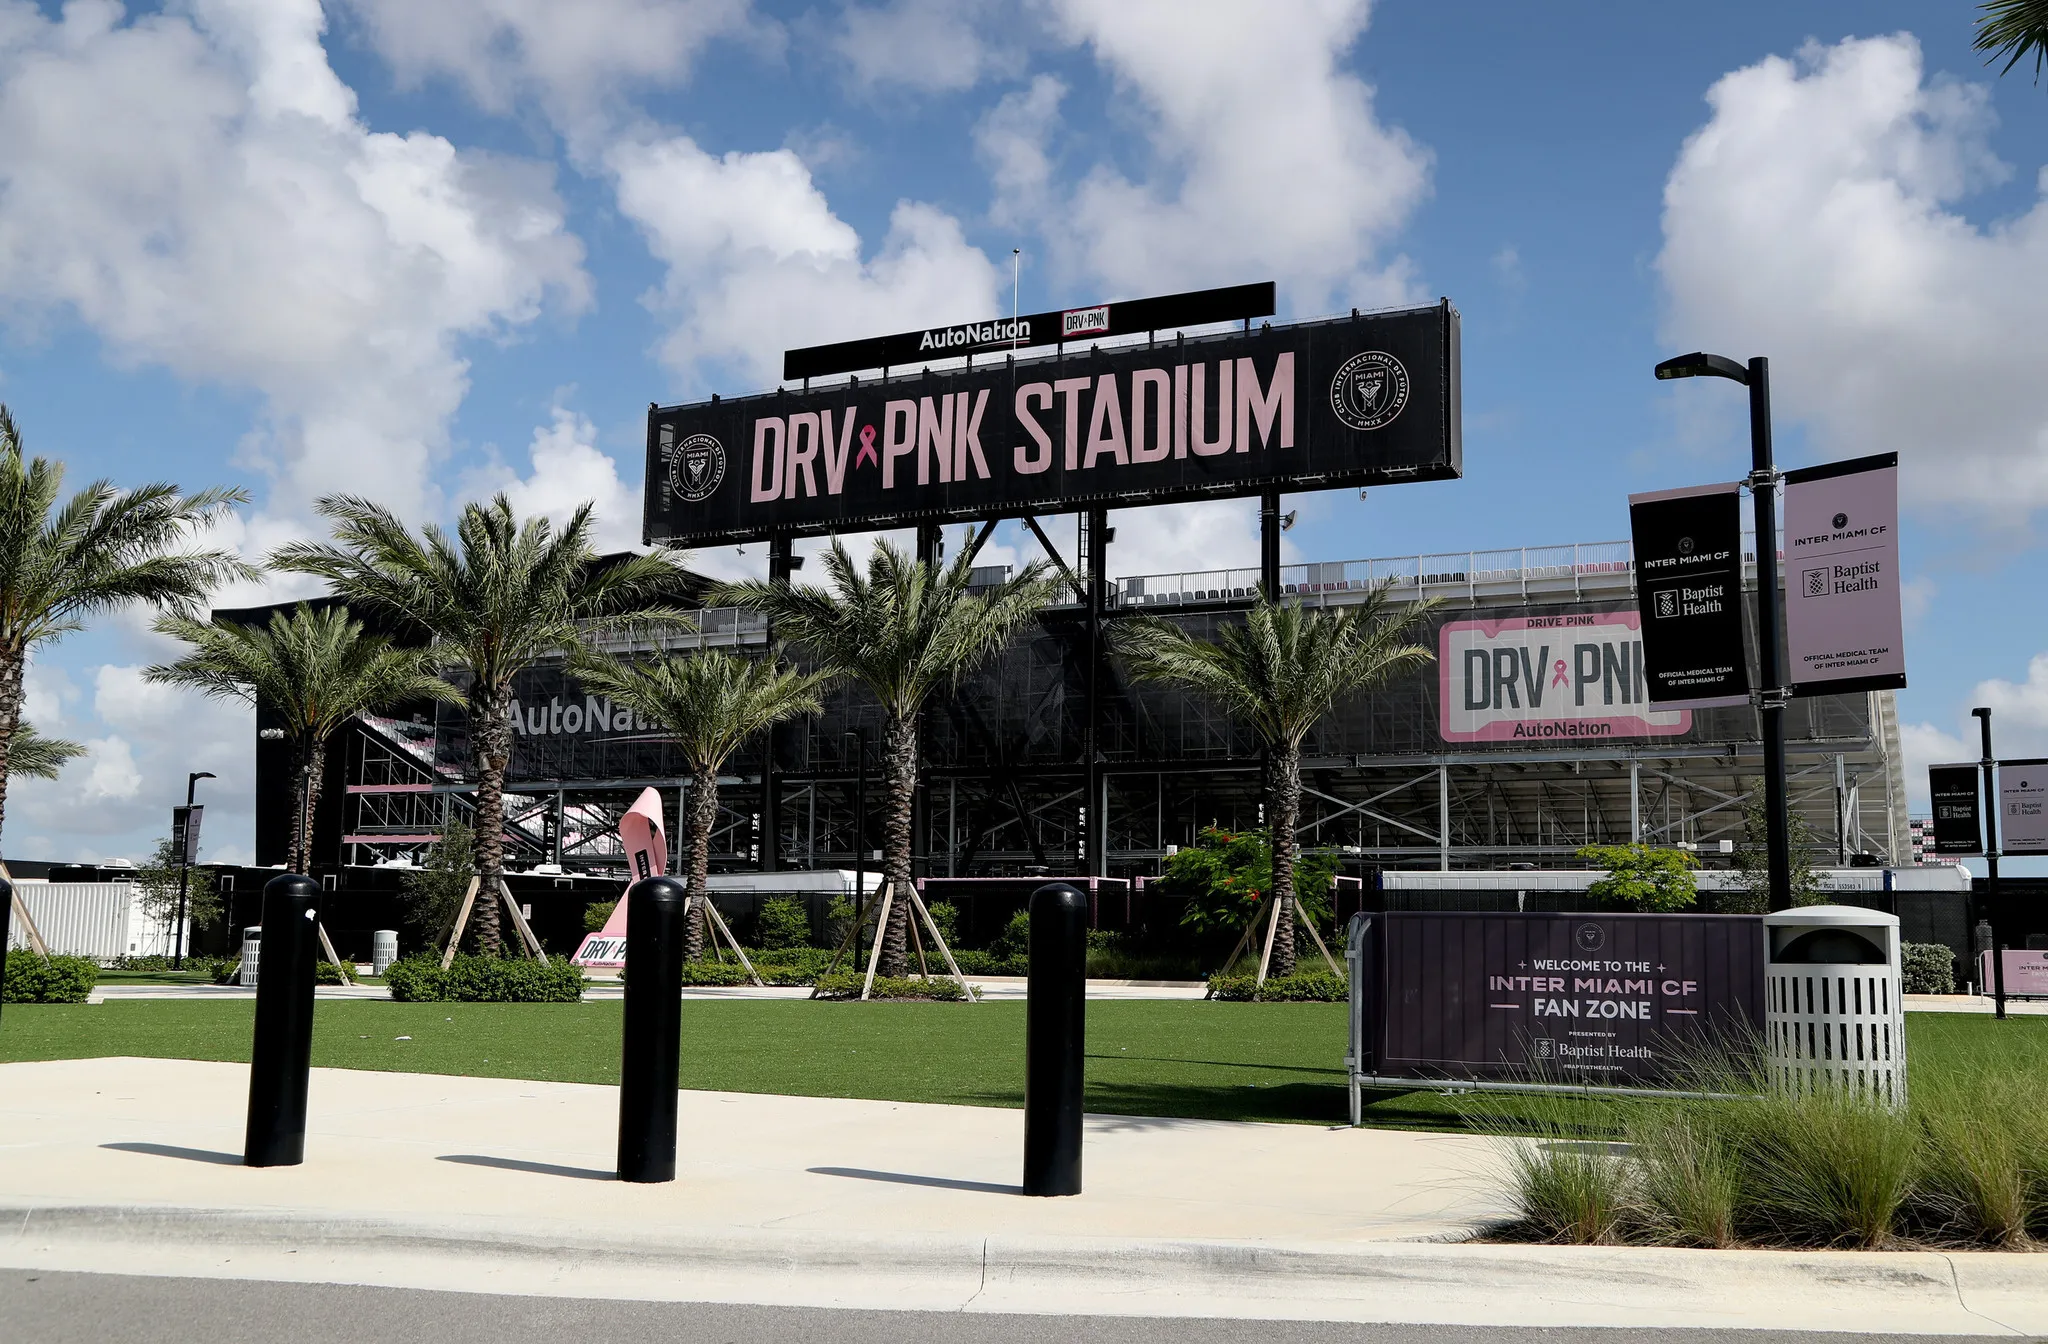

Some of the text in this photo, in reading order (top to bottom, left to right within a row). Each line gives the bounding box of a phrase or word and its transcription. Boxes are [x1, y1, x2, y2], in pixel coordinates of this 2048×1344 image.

[1066, 311, 1105, 330] DRV PNK
[919, 320, 1030, 350] AutoNation
[1335, 355, 1392, 390] INTERNACIONAL
[1355, 371, 1384, 380] MIAMI
[1393, 365, 1403, 376] DE
[1334, 393, 1345, 414] CLUB
[750, 352, 1295, 503] DRV PNK STADIUM
[1358, 418, 1382, 426] MMXX
[673, 437, 716, 467] INTERNACIONAL
[686, 451, 709, 459] MIAMI
[1794, 526, 1887, 546] INTER MIAMI CF
[1645, 551, 1730, 569] INTER MIAMI CF
[1833, 561, 1880, 579] Baptist
[1682, 584, 1724, 603] Baptist
[1834, 576, 1878, 594] Health
[1683, 600, 1723, 616] Health
[1527, 615, 1595, 628] DRIVE PINK
[1803, 647, 1889, 662] OFFICIAL MEDICAL TEAM
[1464, 645, 1550, 710] DRV
[1686, 668, 1715, 676] MEDICAL
[1696, 676, 1716, 684] MIAMI
[1513, 721, 1612, 738] AutoNation
[580, 940, 616, 959] DRV
[1533, 959, 1650, 973] WELCOME TO THE
[1489, 975, 1697, 996] INTER MIAMI CF
[1534, 998, 1651, 1020] FAN ZONE
[1559, 1043, 1652, 1059] Baptist Health
